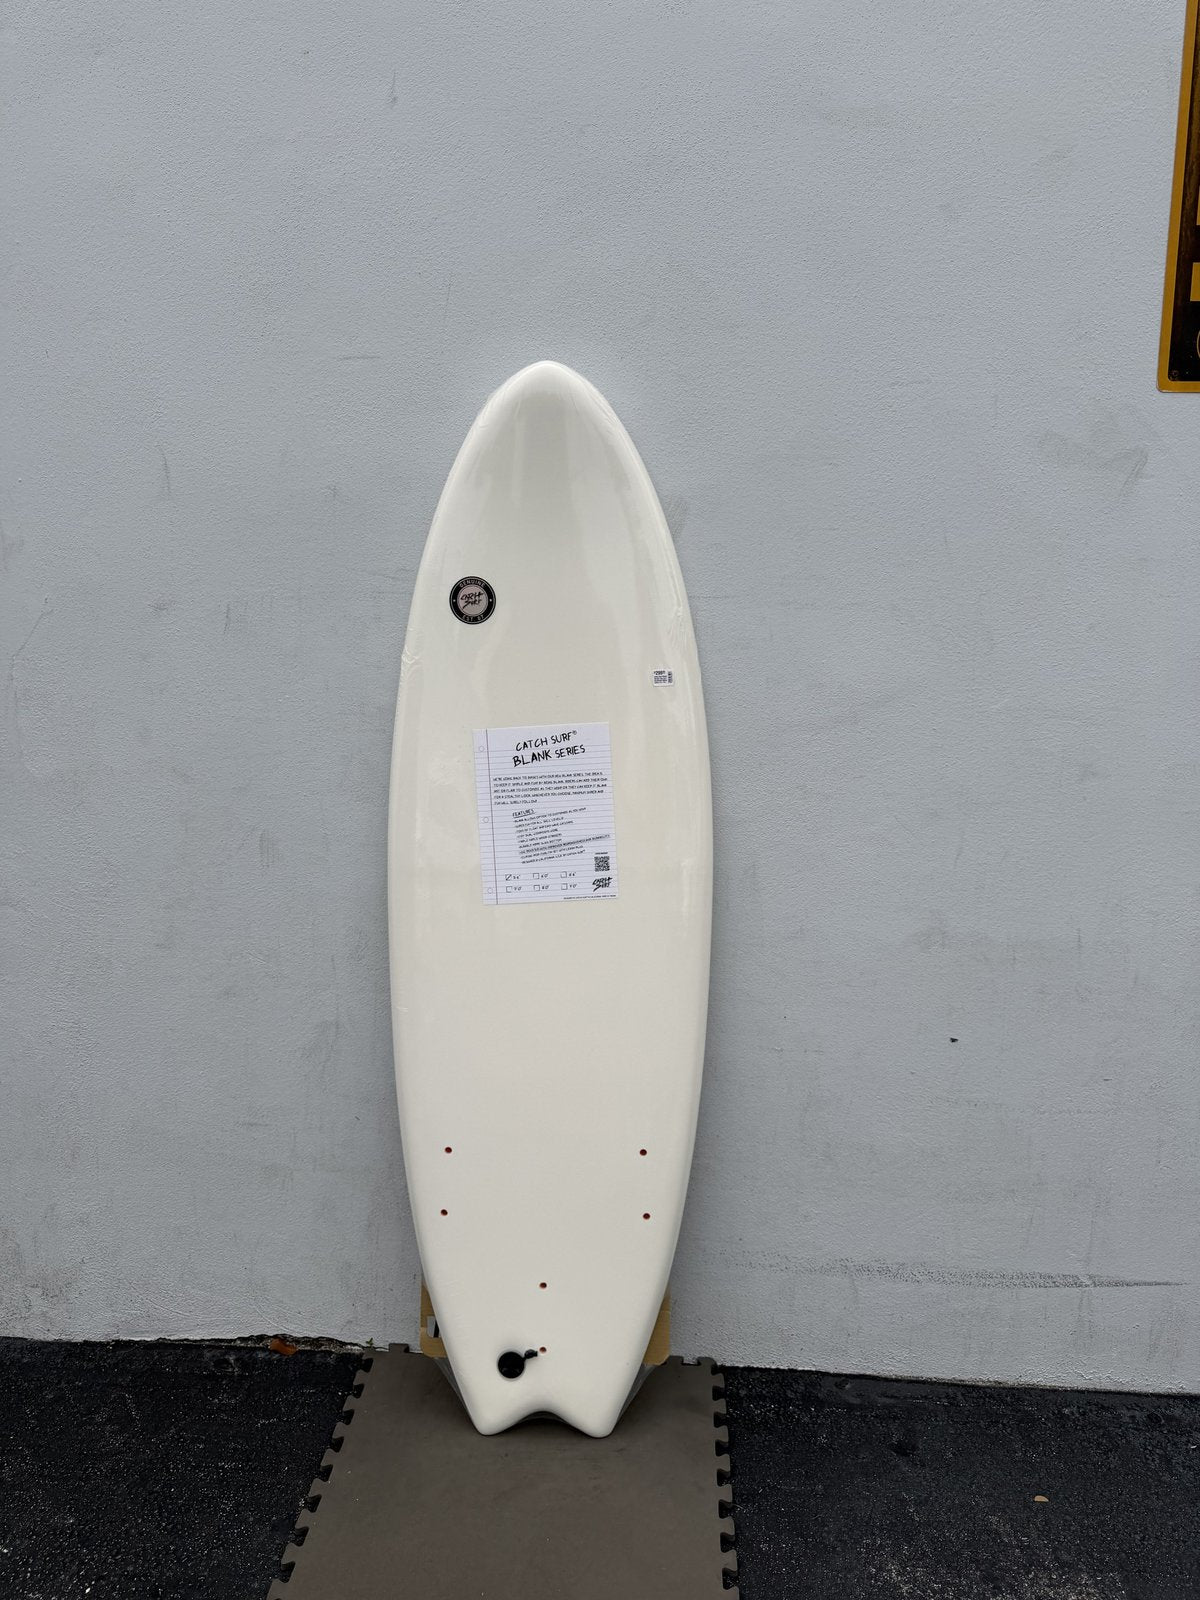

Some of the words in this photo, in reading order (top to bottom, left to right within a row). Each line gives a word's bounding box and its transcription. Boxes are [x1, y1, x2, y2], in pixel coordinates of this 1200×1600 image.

[516, 737, 548, 752] CATCH
[512, 749, 552, 767] BLANK
[555, 744, 586, 758] SERIES
